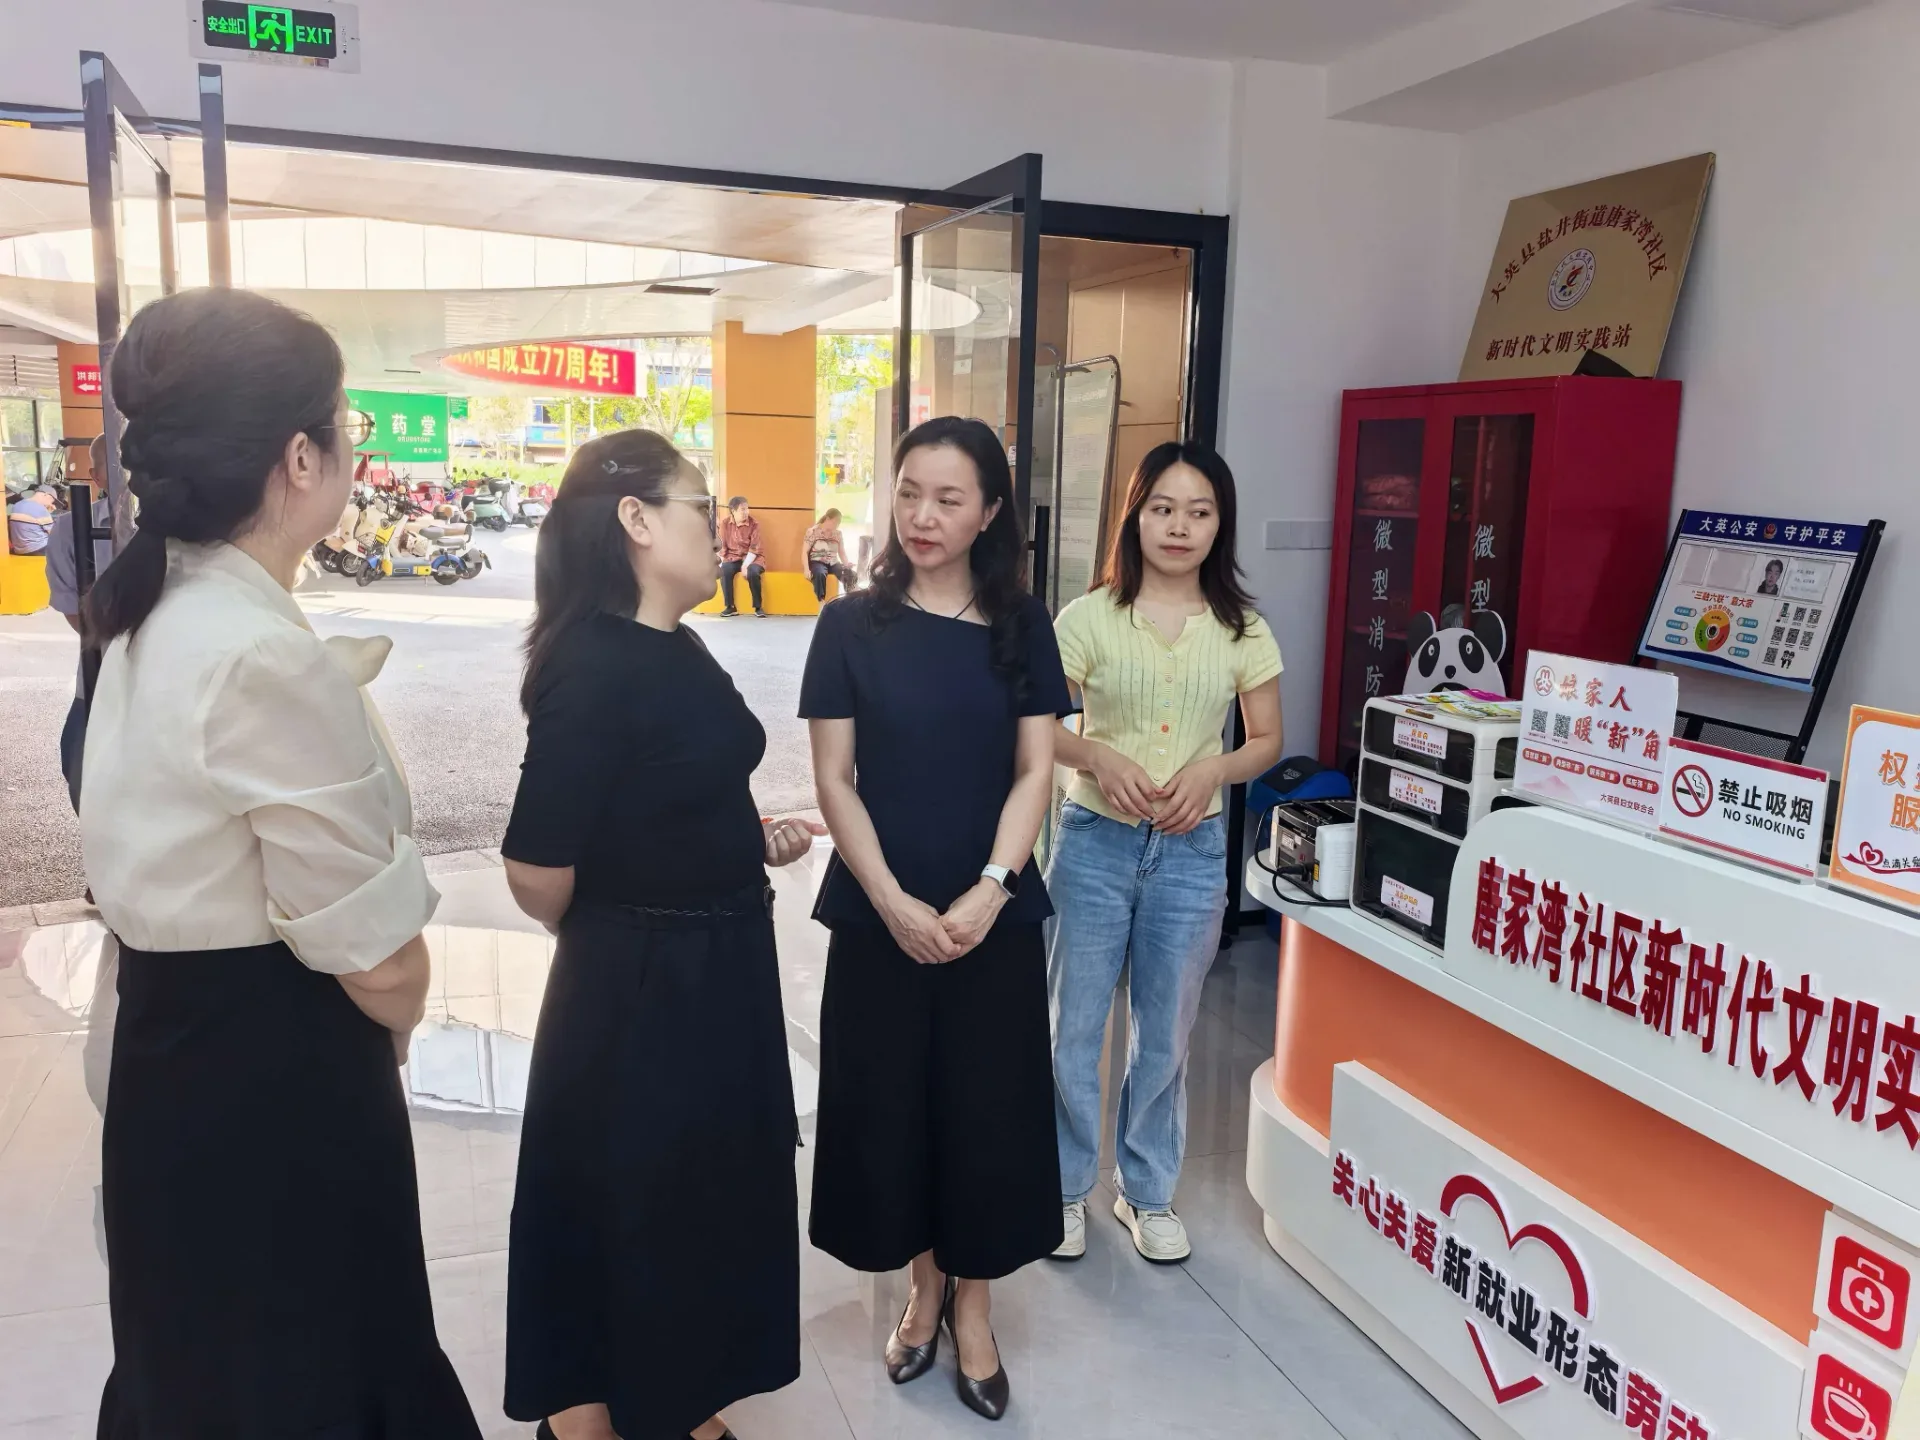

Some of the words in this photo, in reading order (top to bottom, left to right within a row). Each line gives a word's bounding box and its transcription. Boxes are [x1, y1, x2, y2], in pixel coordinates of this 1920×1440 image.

[207, 15, 246, 35] 安全出口
[295, 25, 332, 45] EXIT
[1490, 204, 1668, 304] 大英县盐井街道唐家湾社区
[1485, 323, 1633, 362] 新时代文明实践站
[1699, 517, 1758, 538] 大英公安
[1784, 524, 1847, 547] 守护平安
[1471, 524, 1497, 614] 微型
[1365, 519, 1394, 697] 微型消防
[1559, 673, 1633, 713] 娘家人
[1573, 714, 1662, 762] 暖“新”角
[1600, 793, 1655, 816] 大英县妇女联合会
[1718, 778, 1813, 826] 禁止吸烟
[1722, 808, 1741, 823] NO
[1744, 816, 1806, 841] SMOKING
[1471, 855, 1920, 1151] 唐家湾社区新时代文明实
